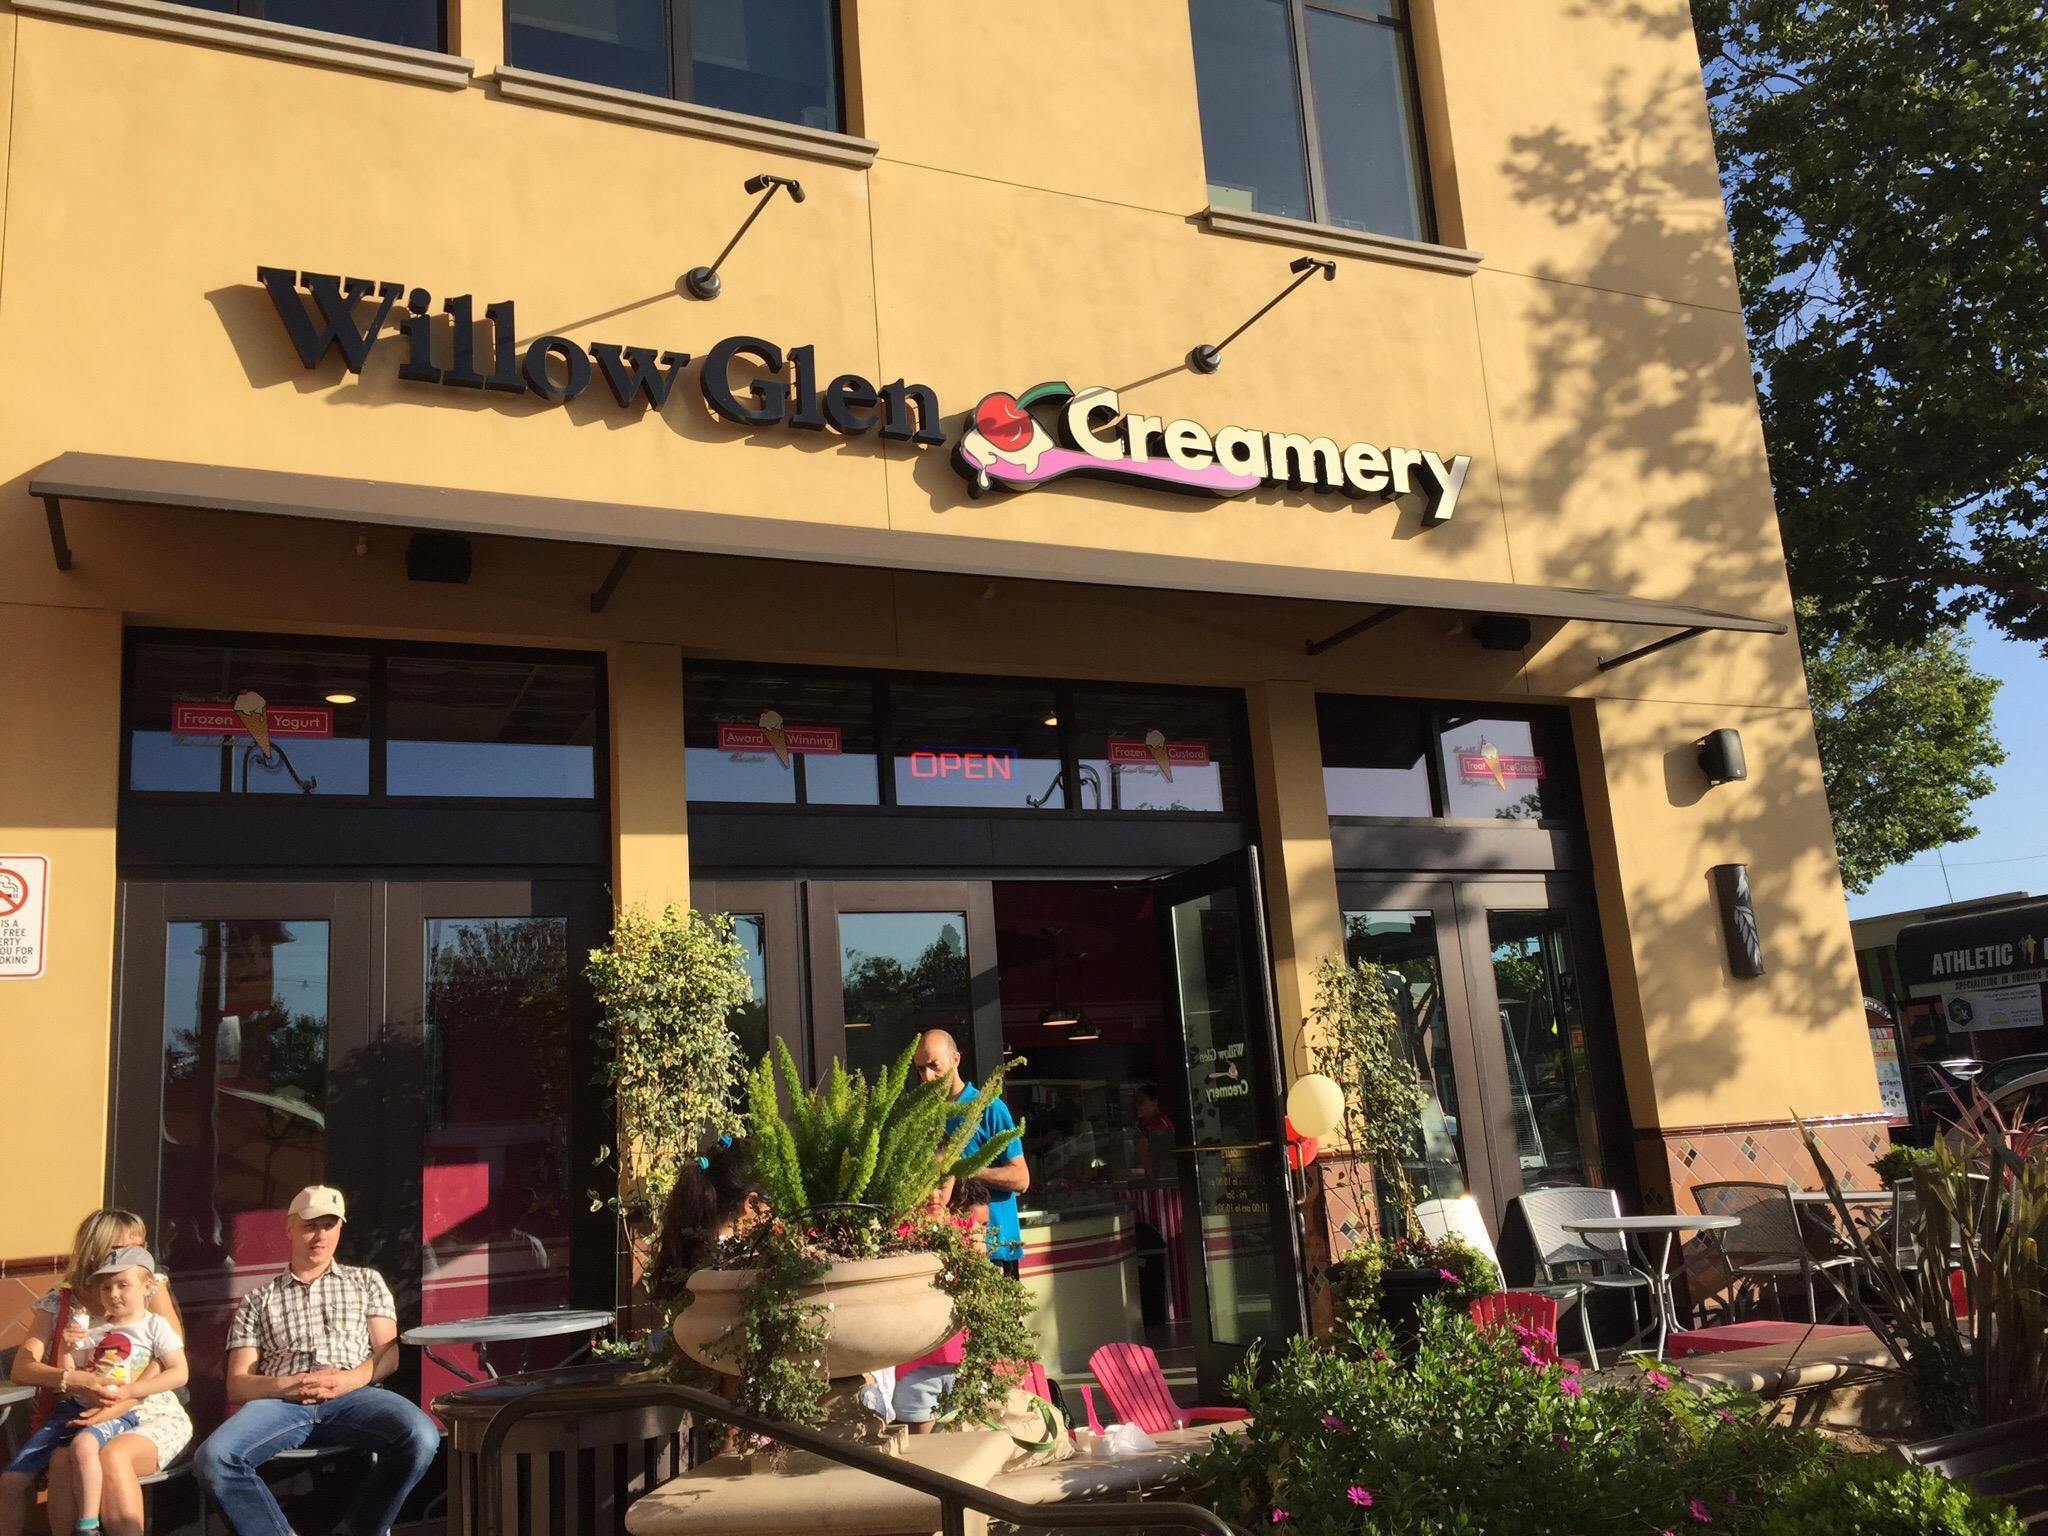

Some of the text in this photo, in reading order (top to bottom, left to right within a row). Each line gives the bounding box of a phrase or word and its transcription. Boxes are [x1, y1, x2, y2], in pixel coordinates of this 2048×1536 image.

[257, 265, 947, 447] Willow Glen
[1065, 386, 1472, 523] Creamery
[183, 711, 320, 730] Frozen Yogurt
[726, 732, 835, 748] Award Winning
[1114, 746, 1206, 759] Frozen Custard
[911, 751, 1012, 780] OPEN
[1, 919, 19, 928] IS A
[3, 928, 27, 937] FREE
[15, 946, 34, 955] FOR
[1931, 943, 2013, 976] ATHLETIC
